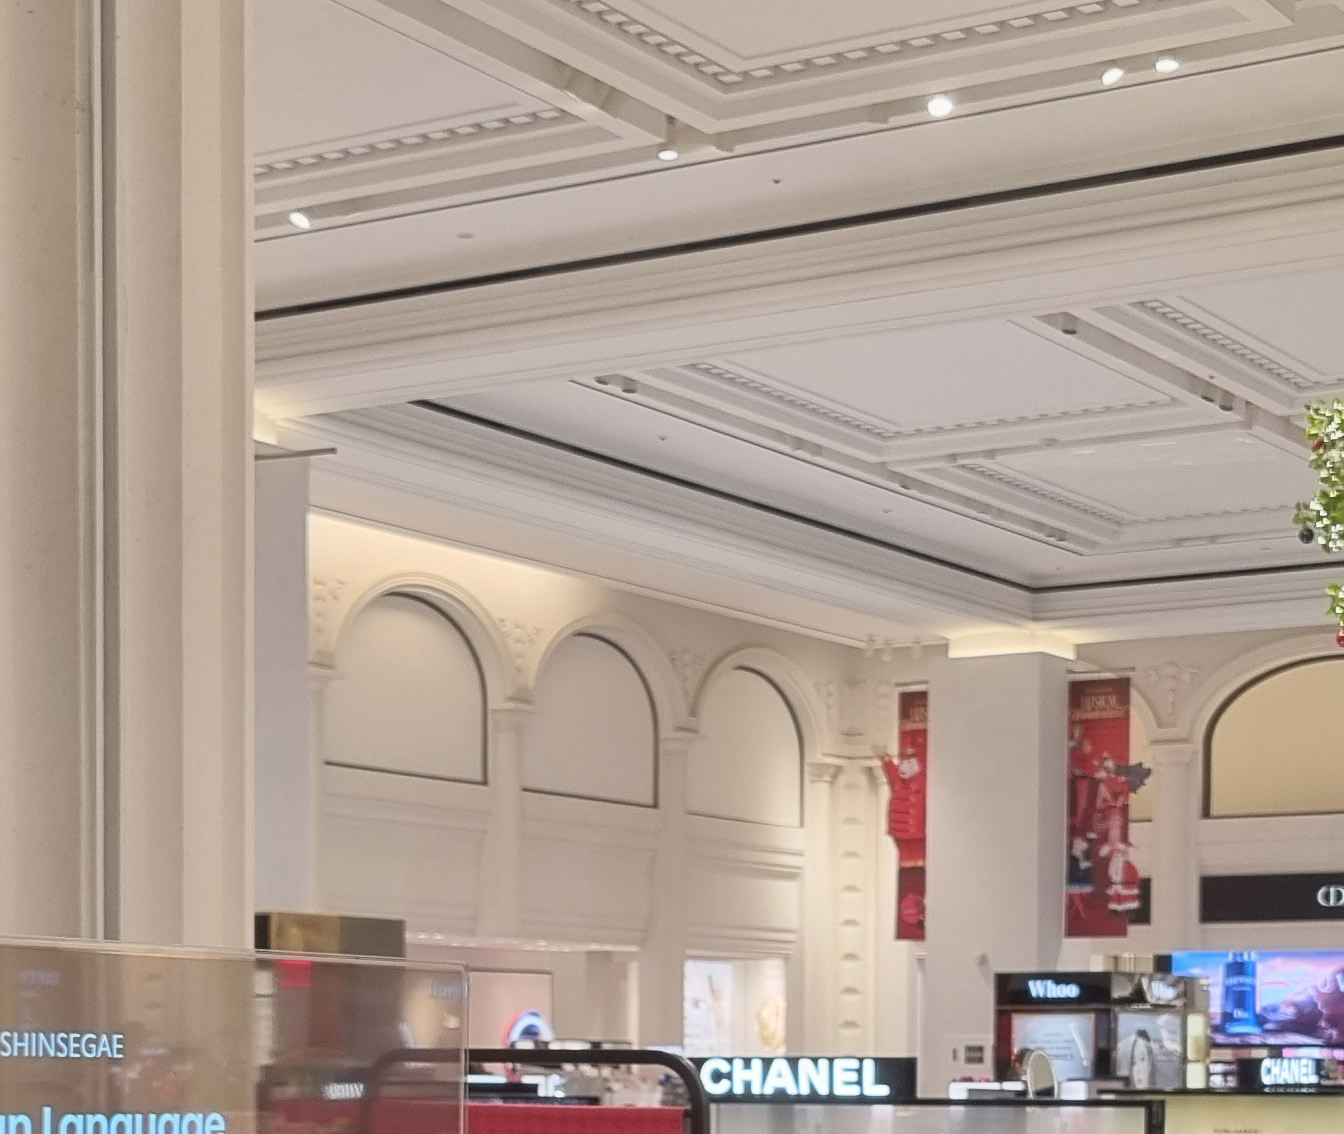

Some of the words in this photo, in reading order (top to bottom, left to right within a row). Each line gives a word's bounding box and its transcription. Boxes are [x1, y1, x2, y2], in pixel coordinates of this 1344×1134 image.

[1028, 979, 1081, 999] Whoo
[0, 1031, 124, 1058] SHINSEGAE
[700, 1057, 891, 1098] CHANEL
[1260, 1057, 1320, 1086] CHANEL
